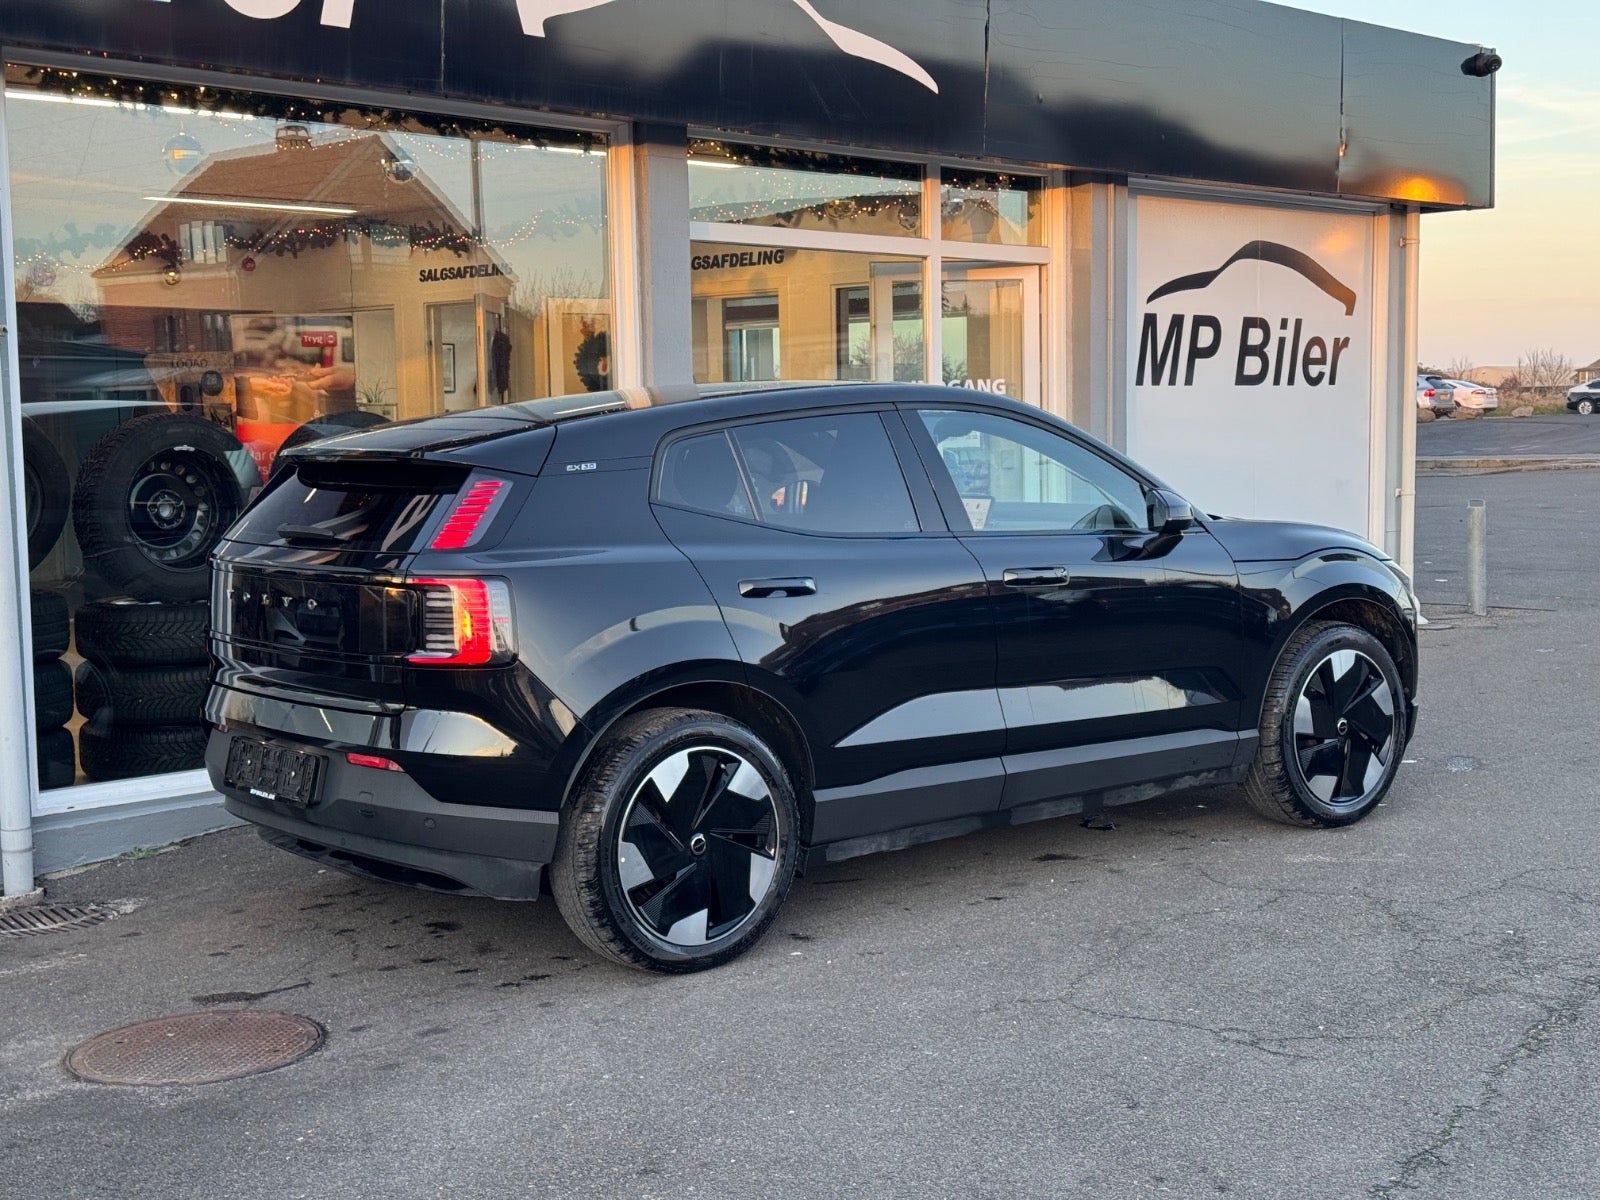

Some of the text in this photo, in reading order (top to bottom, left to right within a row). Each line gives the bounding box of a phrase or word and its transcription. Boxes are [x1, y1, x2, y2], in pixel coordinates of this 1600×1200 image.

[691, 249, 785, 270] GSAFDELING
[1135, 313, 1350, 387] MP Biler
